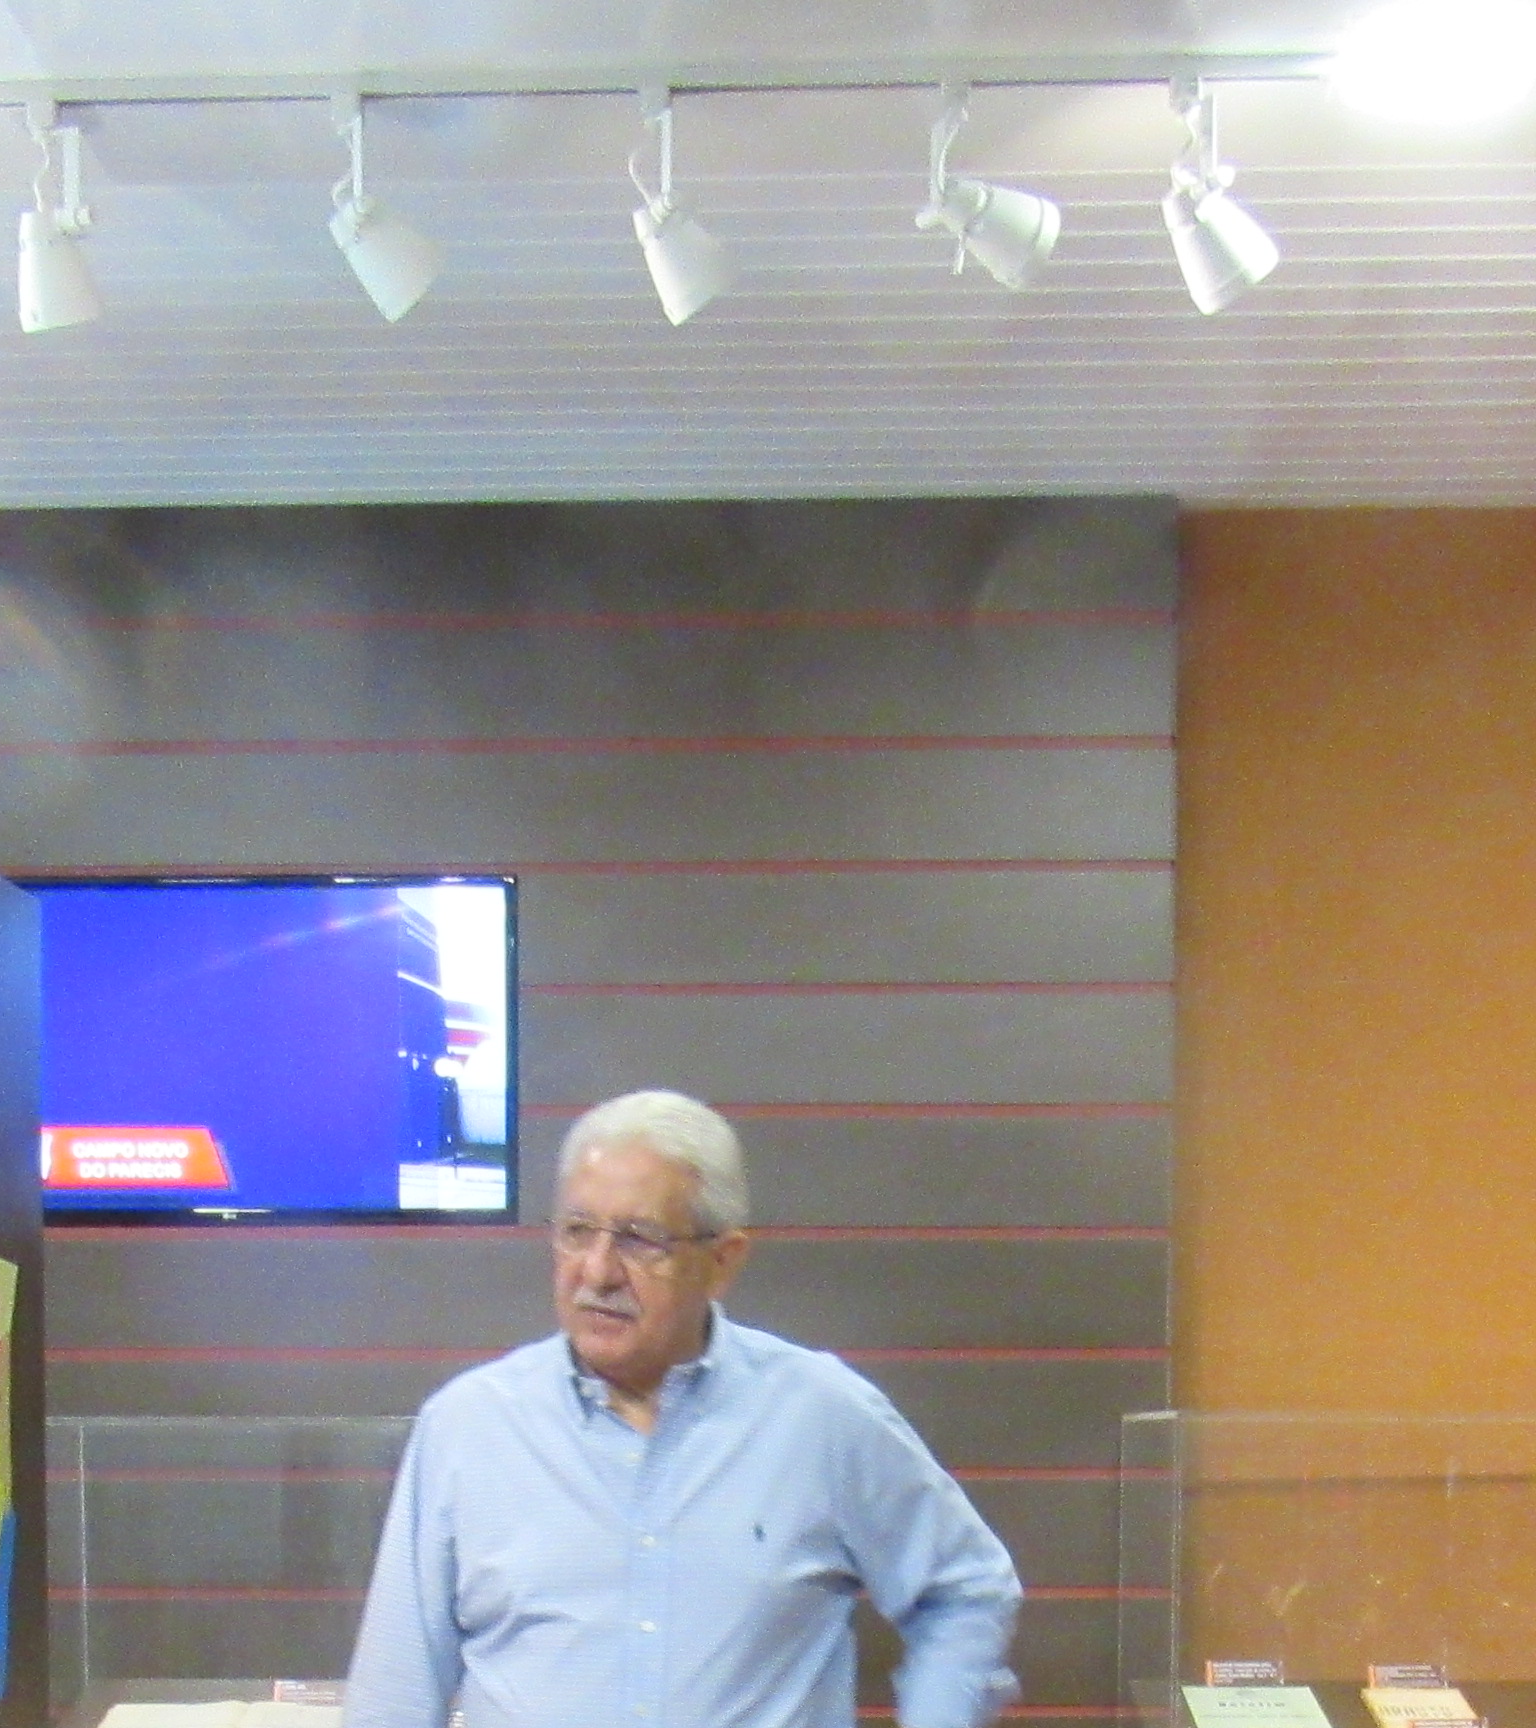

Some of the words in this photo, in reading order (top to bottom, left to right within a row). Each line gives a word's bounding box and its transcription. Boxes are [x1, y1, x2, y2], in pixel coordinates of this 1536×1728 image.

[72, 1141, 135, 1158] CAMPO
[137, 1141, 190, 1158] NOVO
[79, 1162, 106, 1178] DO
[108, 1162, 183, 1178] PARECIS
